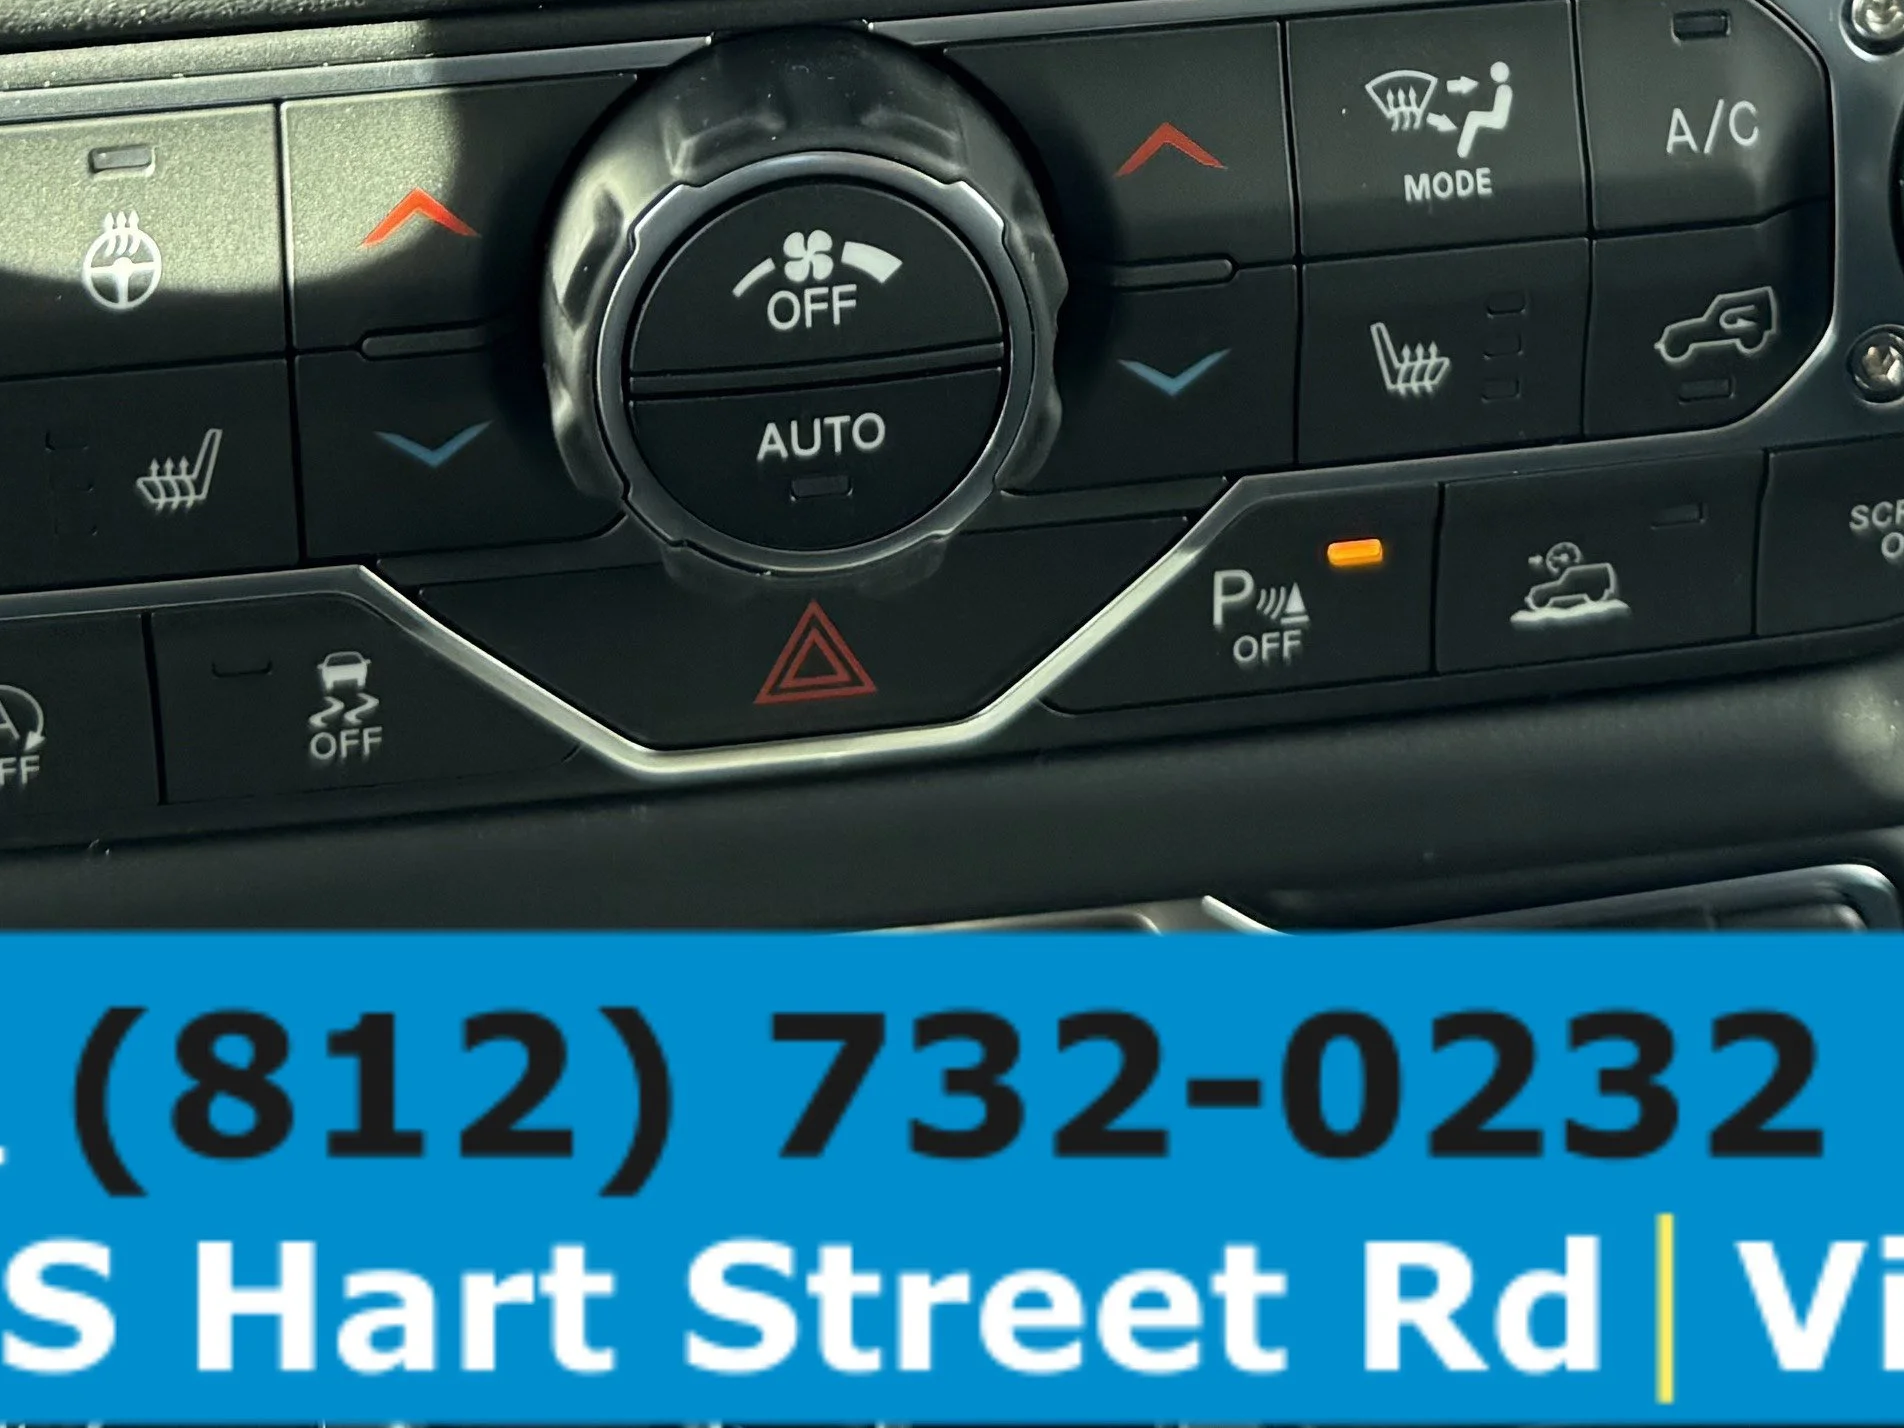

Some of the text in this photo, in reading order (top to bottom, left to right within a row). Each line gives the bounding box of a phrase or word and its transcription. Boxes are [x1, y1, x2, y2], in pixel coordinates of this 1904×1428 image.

[1666, 99, 1760, 155] A/C
[1404, 168, 1492, 202] MODE
[766, 284, 857, 332] OFF
[756, 412, 886, 462] AUTO
[1233, 630, 1302, 664] OFF
[309, 726, 383, 761] OFF
